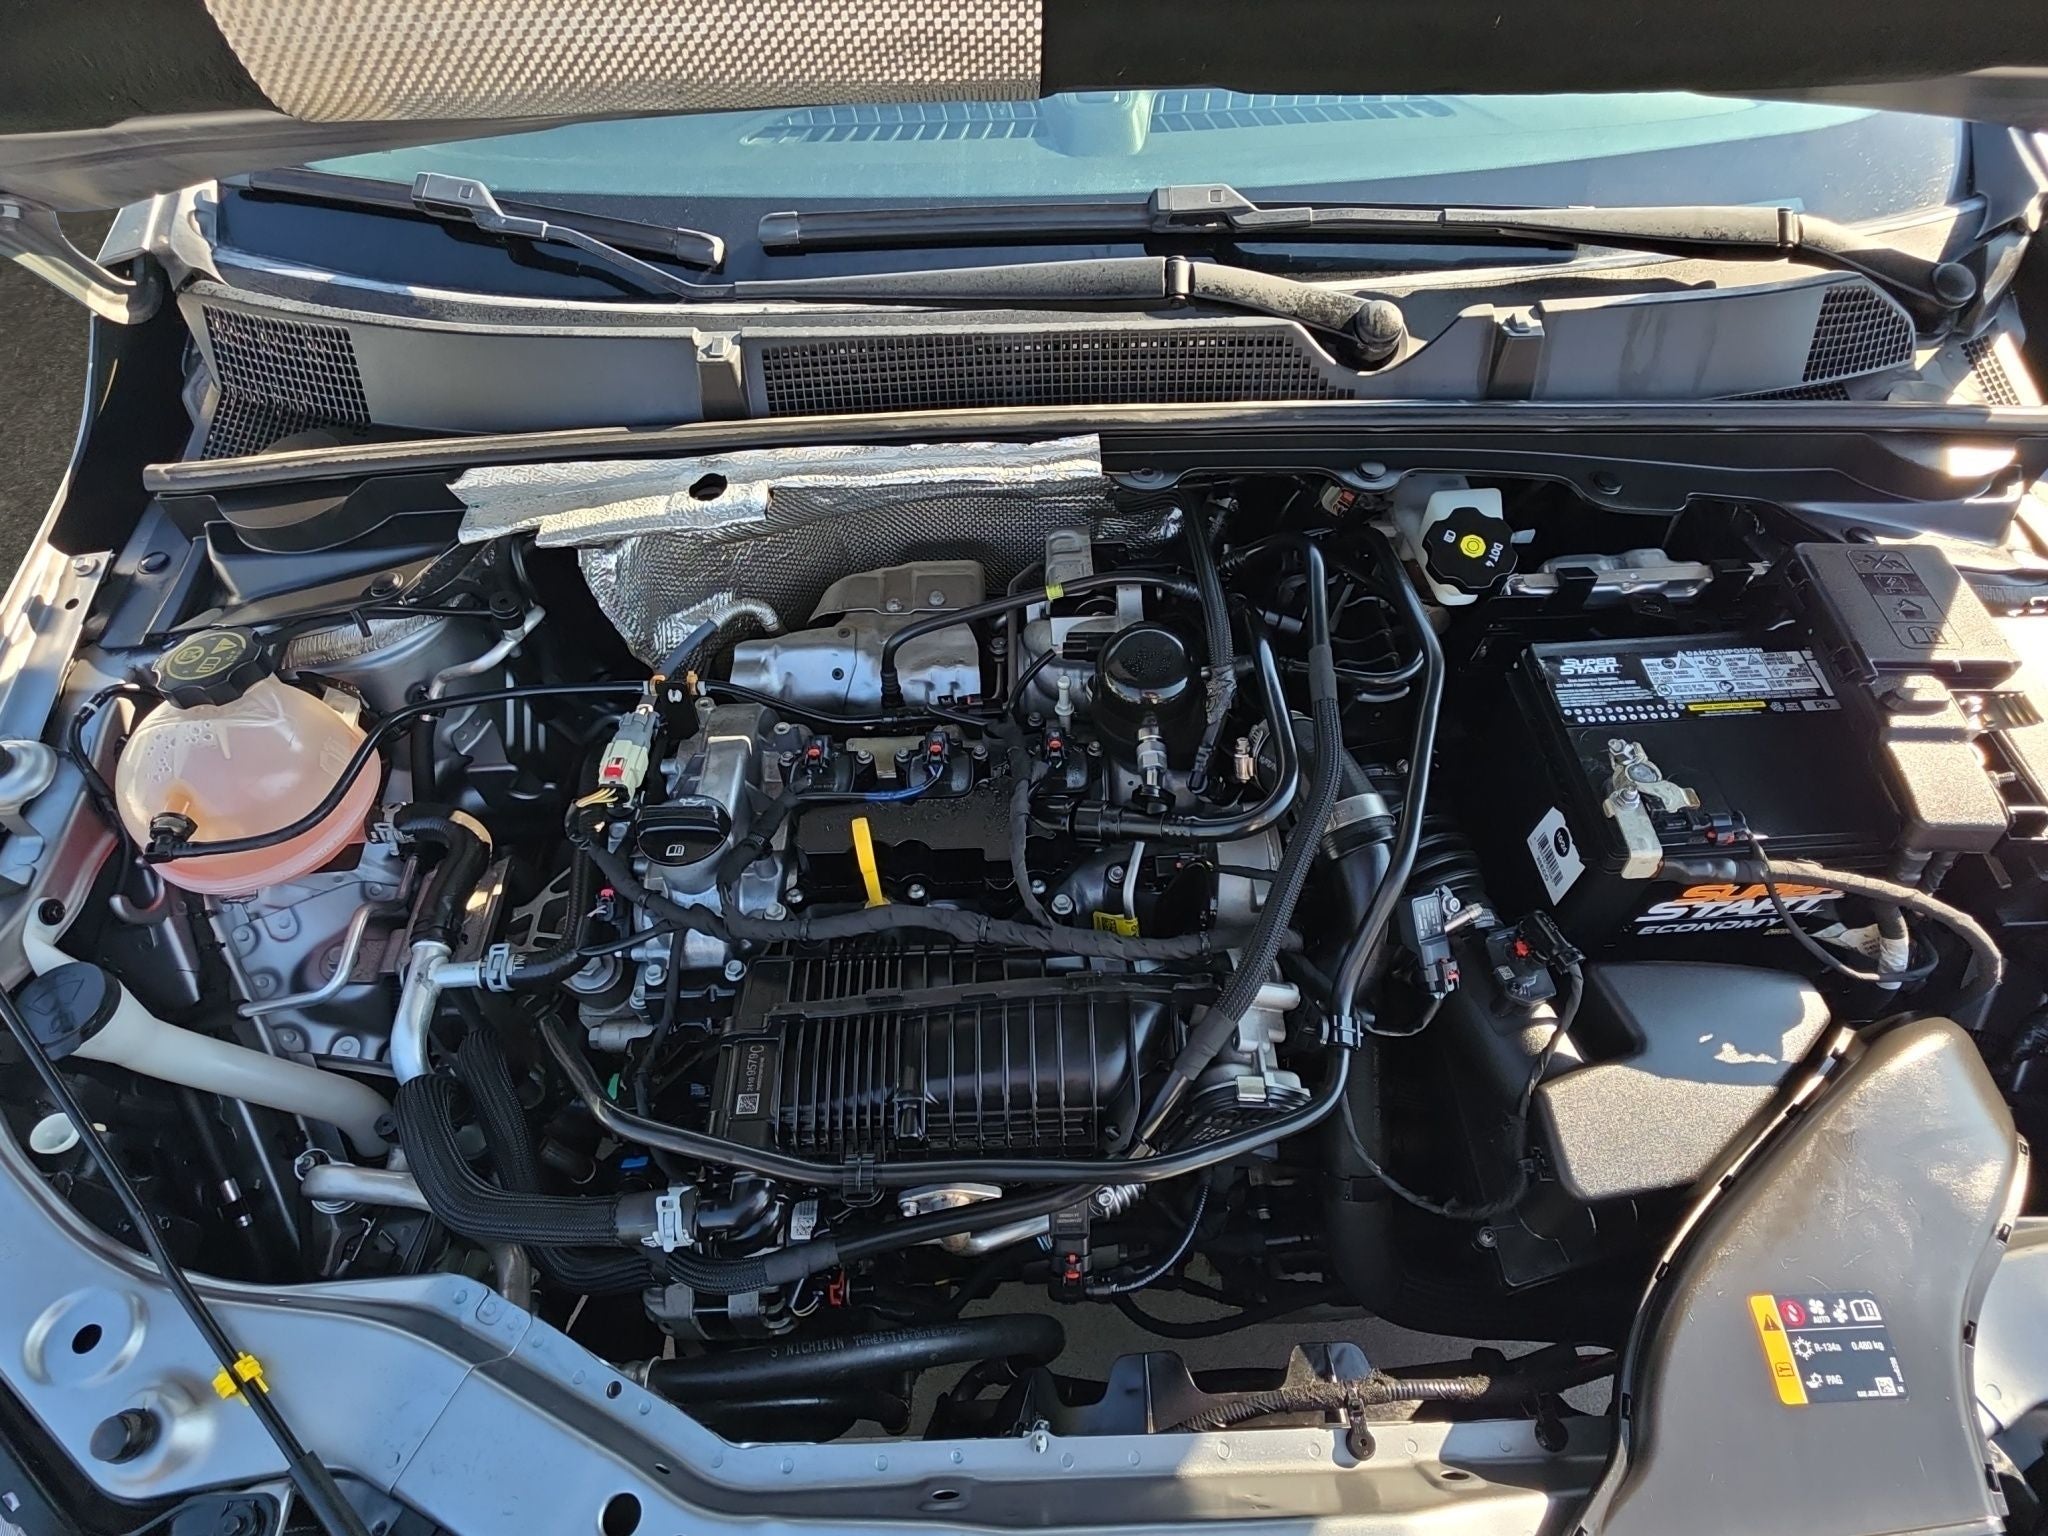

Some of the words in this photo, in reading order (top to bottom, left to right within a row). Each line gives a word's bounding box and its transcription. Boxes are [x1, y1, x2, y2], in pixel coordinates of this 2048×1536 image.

[1488, 541, 1504, 562] DOT
[1563, 657, 1617, 665] SUPER
[1560, 664, 1619, 675] START
[1814, 700, 1831, 709] Pb
[1637, 918, 1784, 936] ECONOMY
[1813, 1315, 1831, 1324] AUTO
[786, 1336, 845, 1356] NICHIRIN
[1814, 1342, 1842, 1352] R-134a
[1873, 1340, 1885, 1351] kg
[1826, 1374, 1844, 1386] PAG
